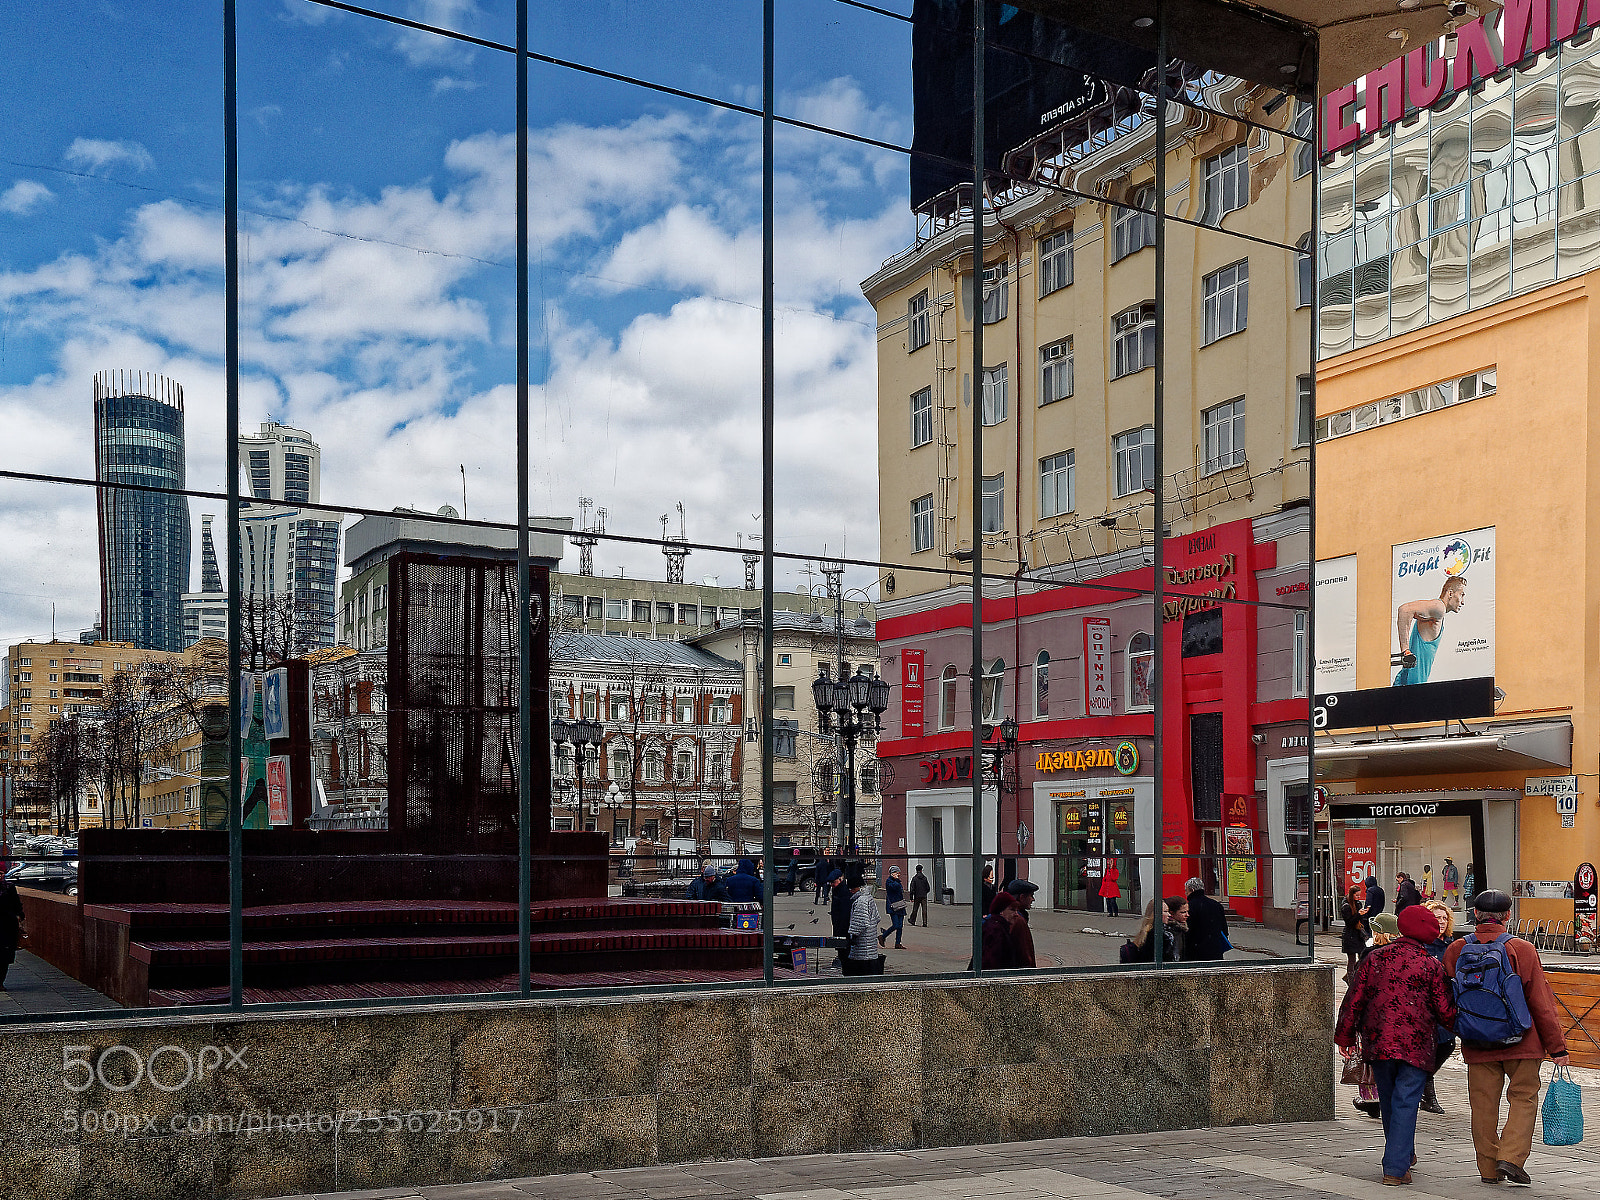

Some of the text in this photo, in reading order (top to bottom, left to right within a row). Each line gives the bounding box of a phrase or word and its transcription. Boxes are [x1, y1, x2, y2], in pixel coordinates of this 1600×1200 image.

[1397, 547, 1491, 578] Bright Fit
[1526, 784, 1574, 793] ВАЙНЕРА
[1558, 797, 1573, 810] 10
[1347, 847, 1372, 855] СКИДКИ
